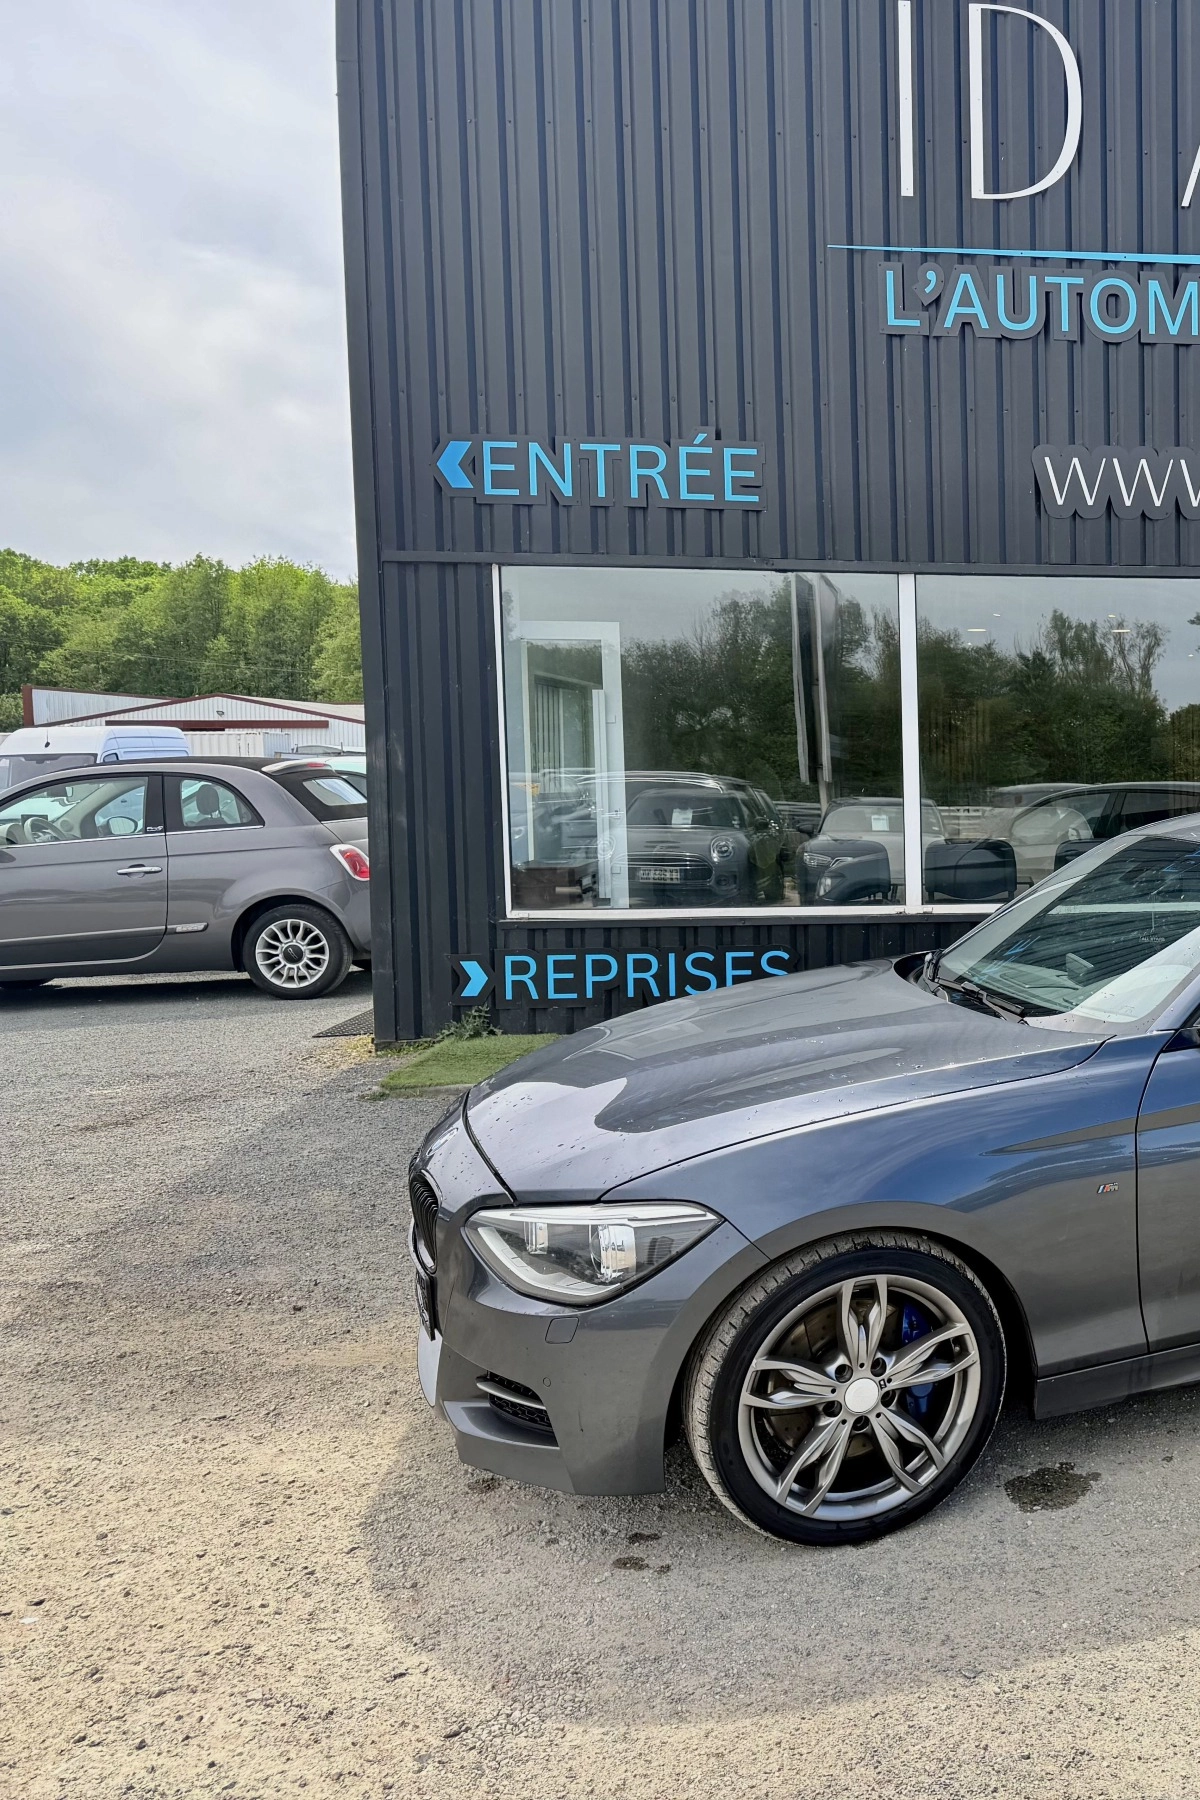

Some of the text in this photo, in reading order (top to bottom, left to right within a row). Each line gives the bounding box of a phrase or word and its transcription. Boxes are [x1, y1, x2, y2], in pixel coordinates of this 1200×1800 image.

[898, 0, 1082, 199] ID
[482, 433, 760, 503] ENTRÉE
[504, 950, 790, 1000] REPRISES
